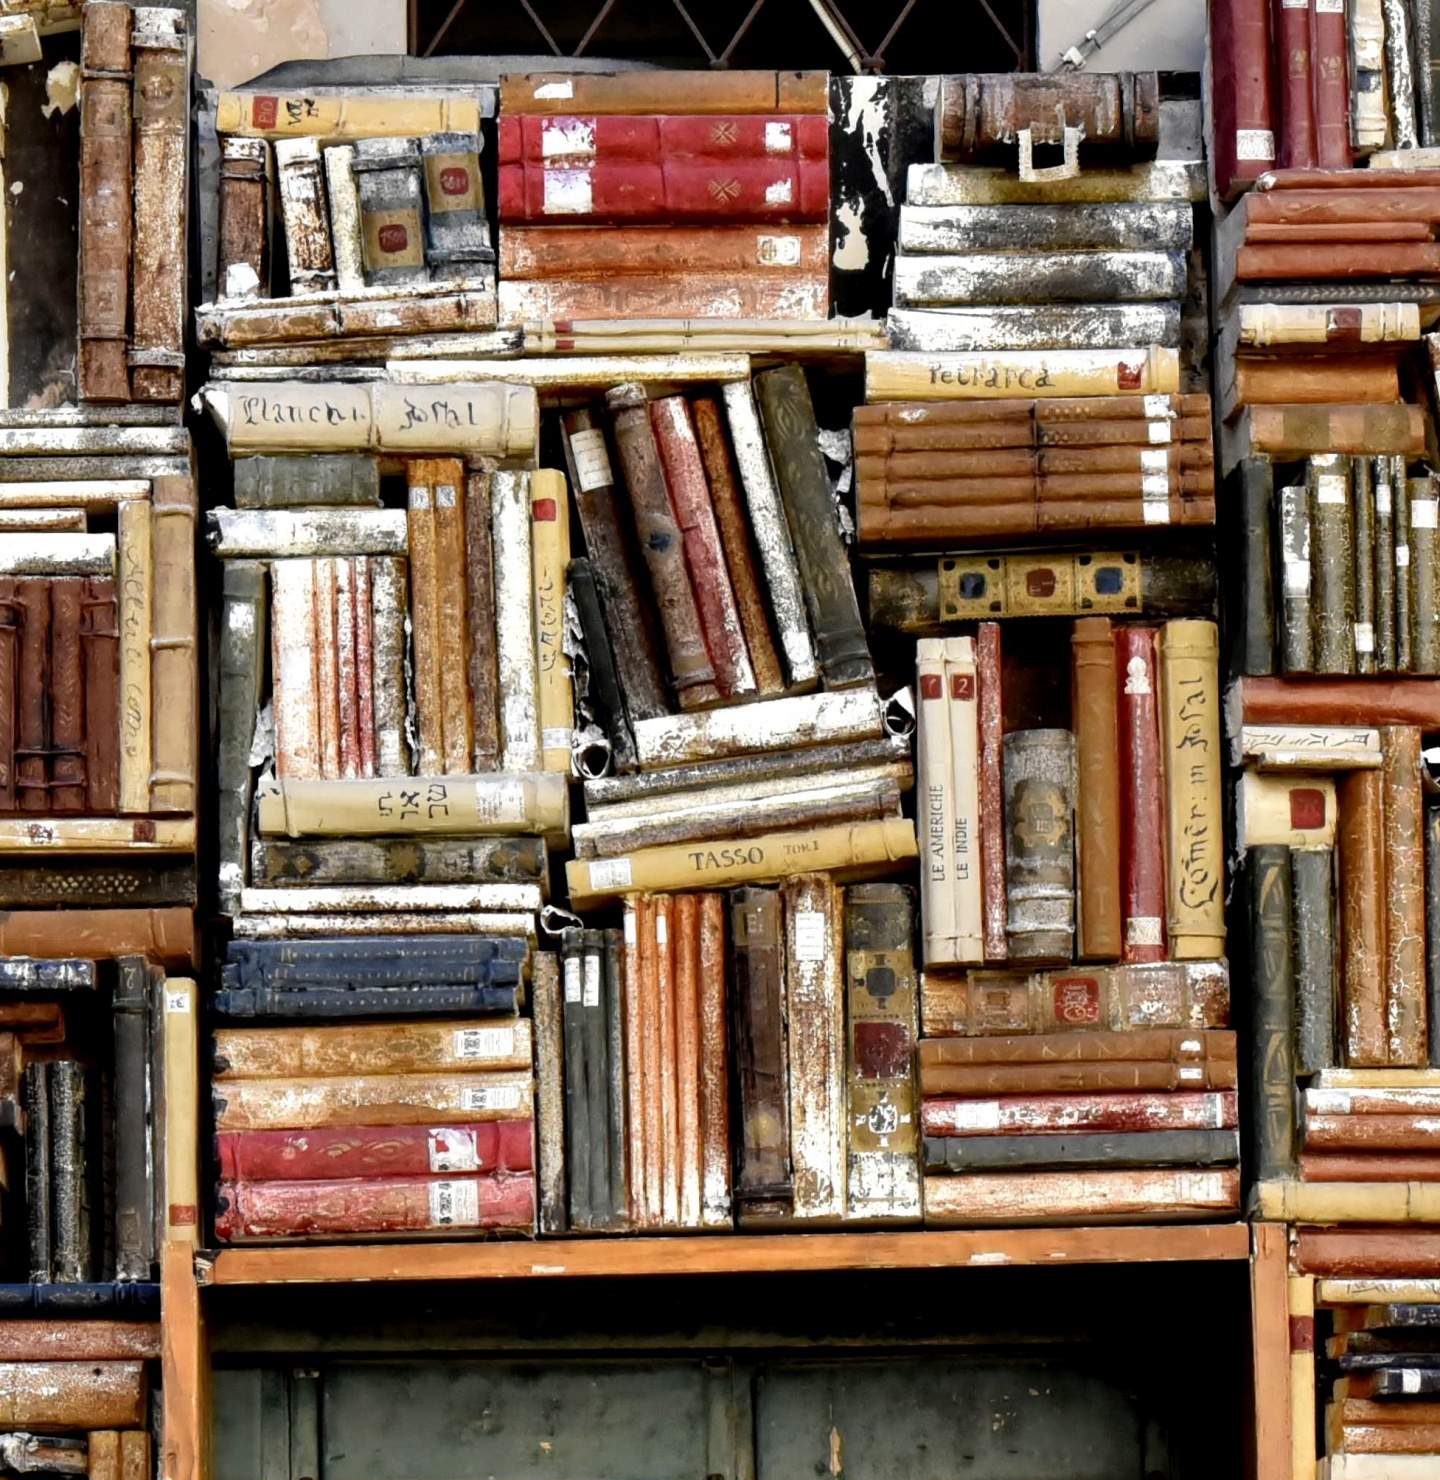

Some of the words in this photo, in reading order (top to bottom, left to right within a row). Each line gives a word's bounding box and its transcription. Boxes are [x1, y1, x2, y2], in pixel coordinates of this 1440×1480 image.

[957, 677, 968, 695] 2
[929, 784, 944, 863] AMERICHE
[955, 817, 968, 854] INDIE
[688, 846, 765, 872] TASSO
[932, 865, 946, 882] LE
[957, 863, 969, 881] LE
